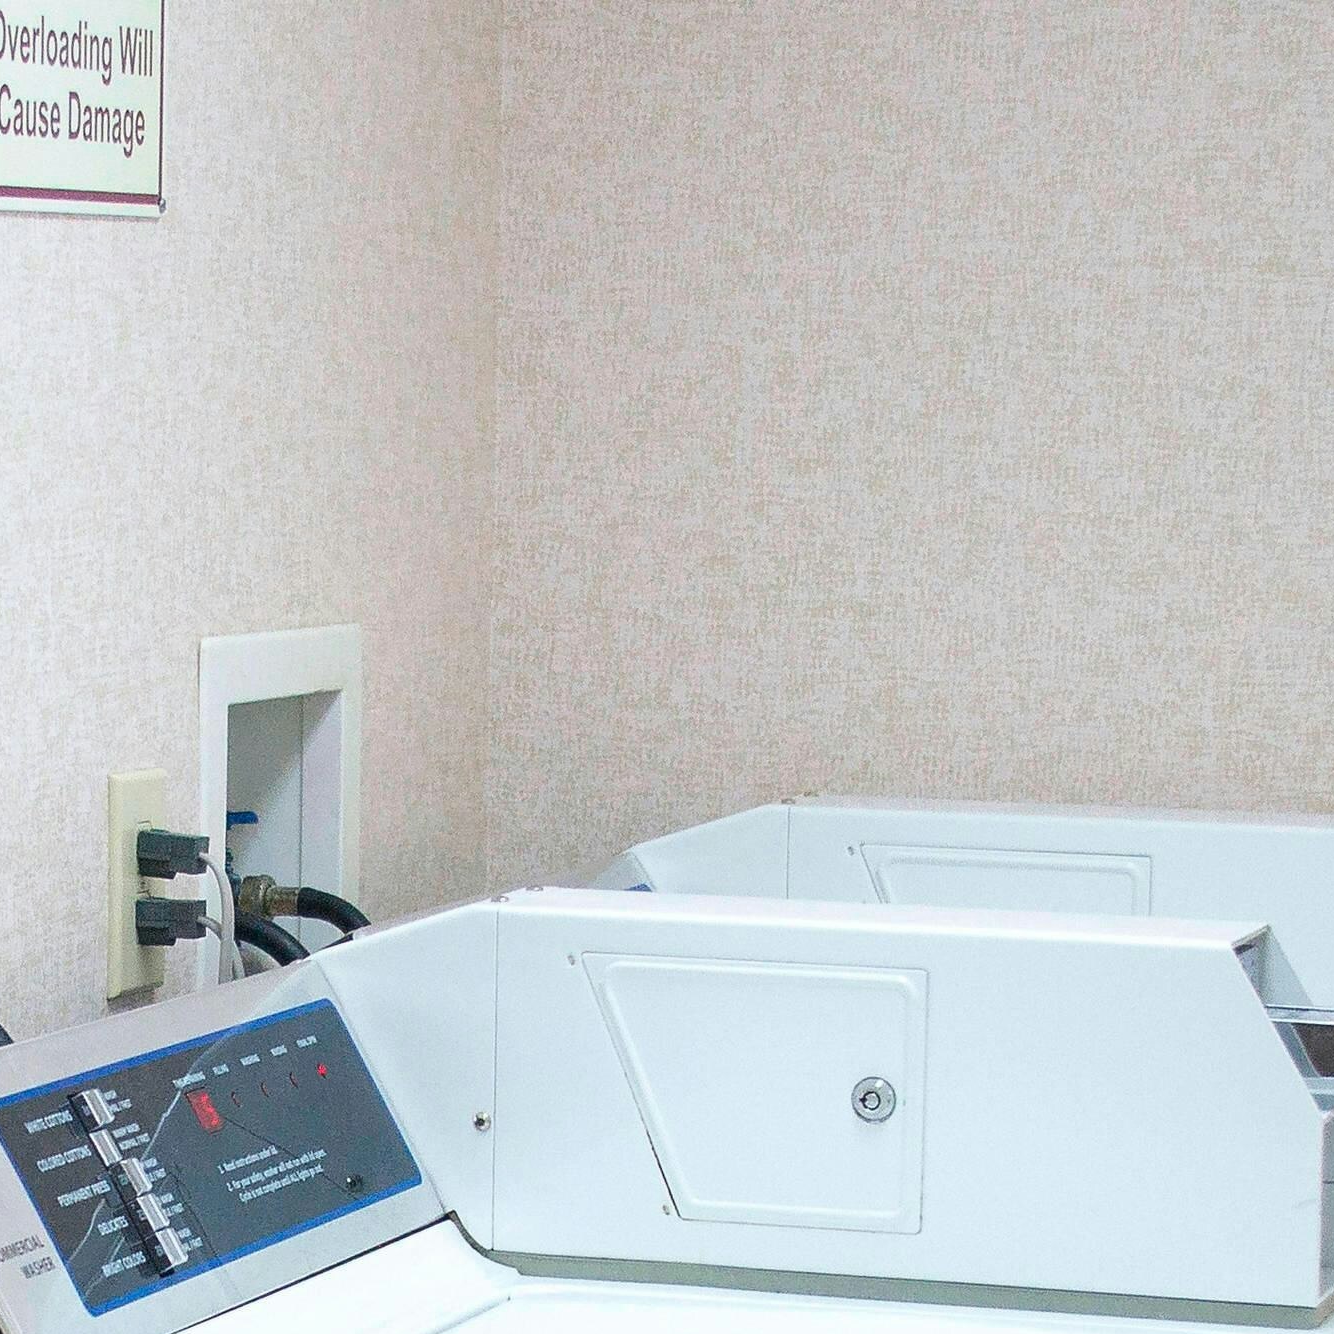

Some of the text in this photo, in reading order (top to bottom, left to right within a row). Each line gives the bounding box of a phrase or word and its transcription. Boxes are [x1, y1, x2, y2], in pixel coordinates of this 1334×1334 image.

[119, 25, 154, 77] Will
[68, 91, 145, 158] Damage
[97, 1215, 130, 1236] DELICATES
[21, 1256, 56, 1279] WASHER
